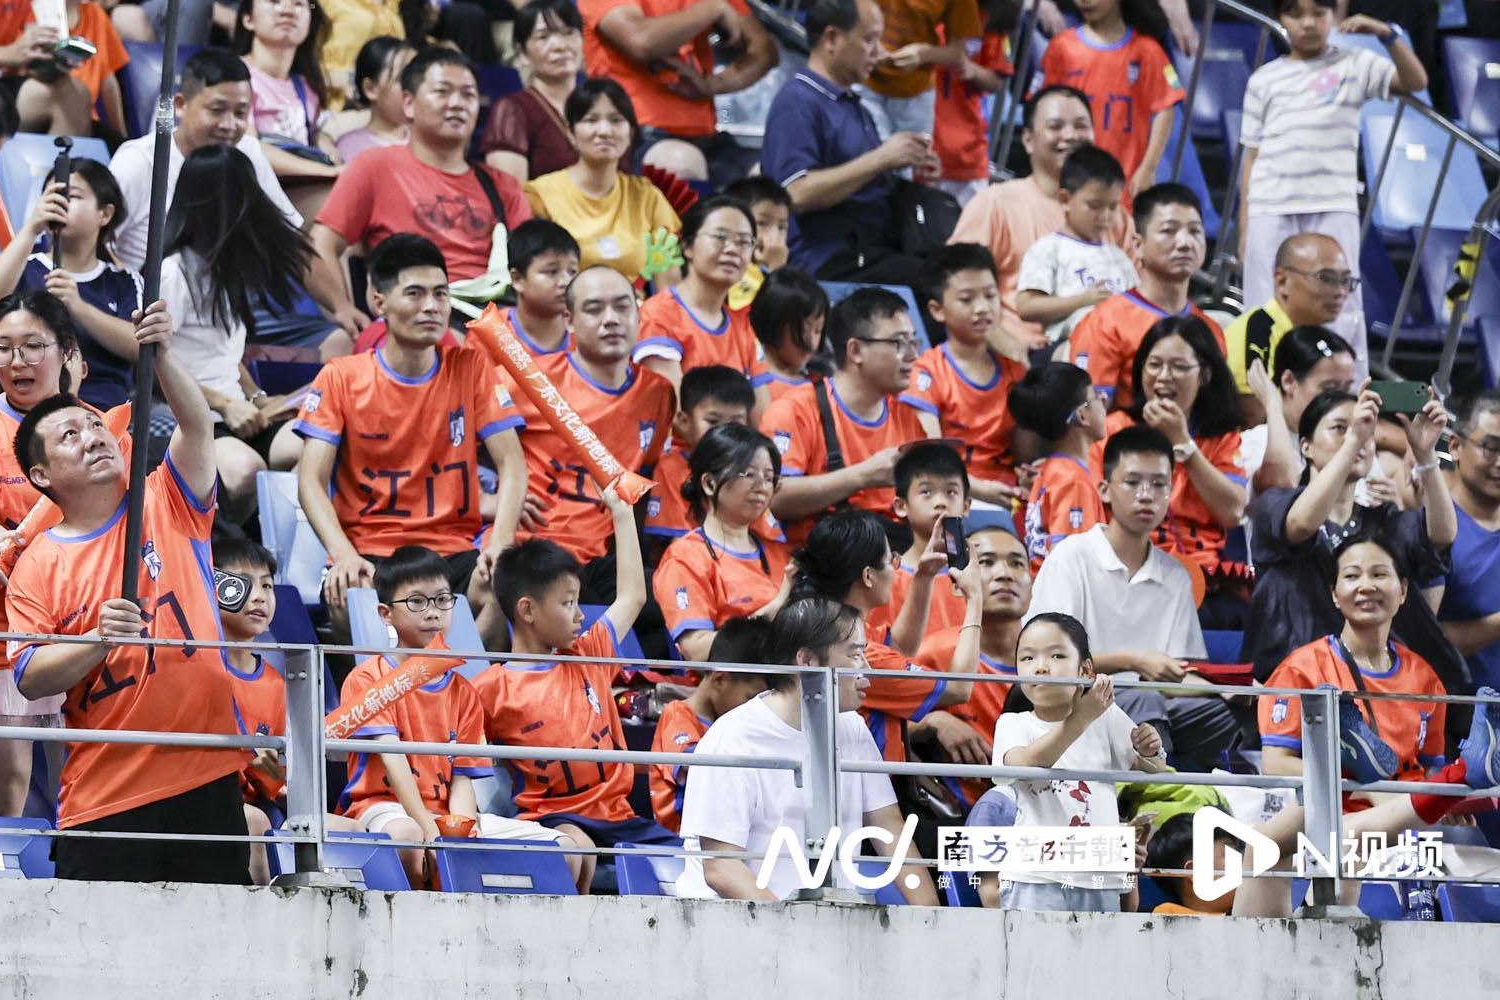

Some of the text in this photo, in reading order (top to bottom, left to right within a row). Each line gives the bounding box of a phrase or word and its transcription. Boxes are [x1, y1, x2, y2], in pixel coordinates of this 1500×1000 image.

[525, 371, 624, 475] 广东文化新地标
[359, 461, 470, 517] 江门
[325, 673, 413, 739] 东文化新地标
